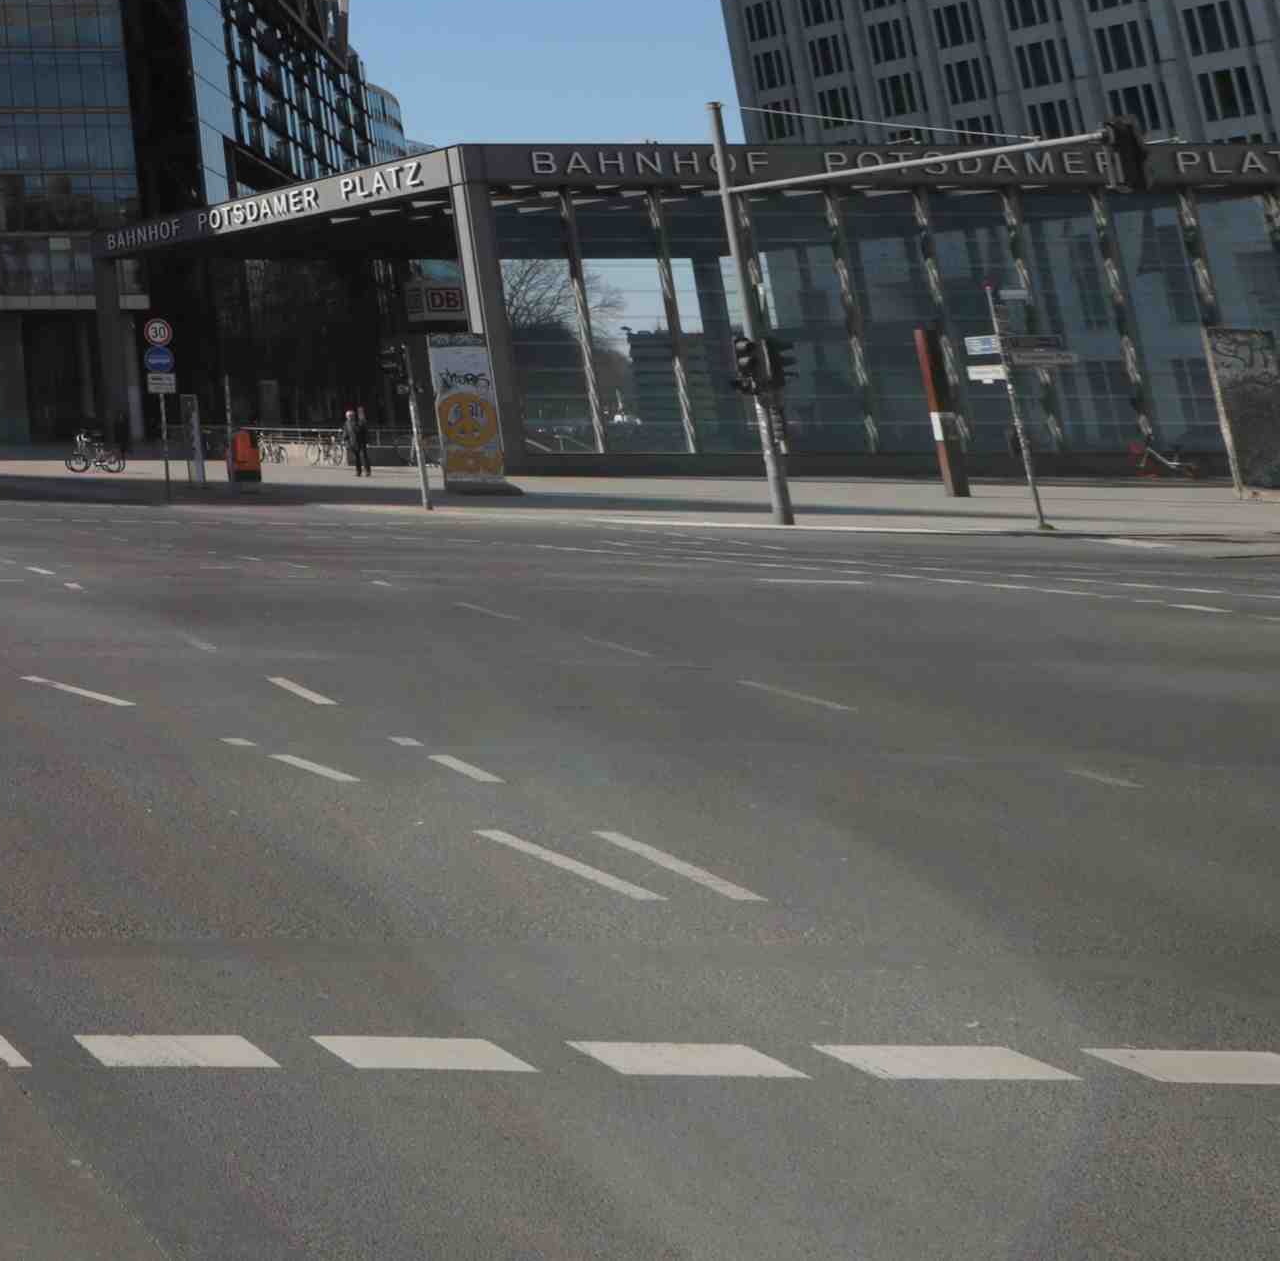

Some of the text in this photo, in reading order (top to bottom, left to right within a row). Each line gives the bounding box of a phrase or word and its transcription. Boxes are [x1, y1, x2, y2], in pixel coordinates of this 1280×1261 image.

[531, 150, 770, 175] BAHNHOF
[106, 162, 424, 251] BAHNHOF POTSDAMER PLATZ
[429, 289, 459, 310] DB
[150, 326, 166, 339] 30
